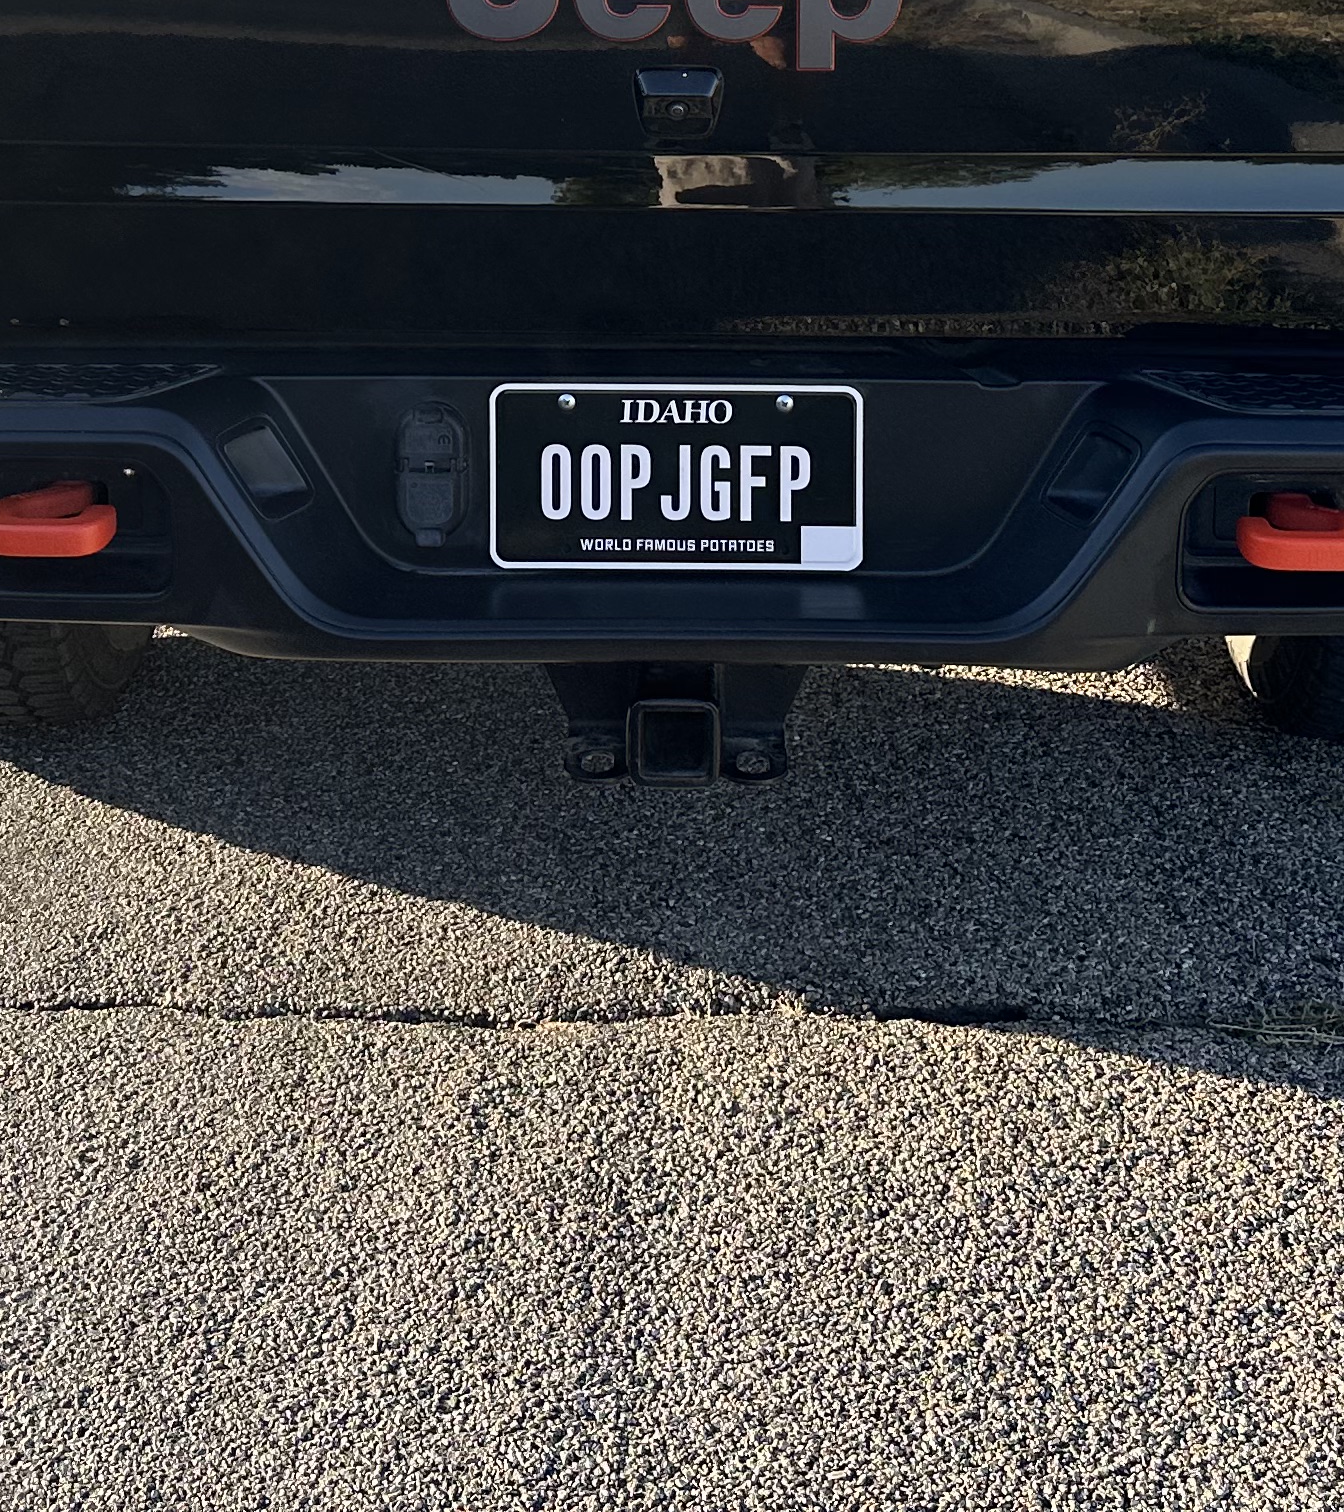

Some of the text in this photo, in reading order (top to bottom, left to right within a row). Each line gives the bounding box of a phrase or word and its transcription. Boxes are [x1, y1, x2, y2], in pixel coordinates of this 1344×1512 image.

[619, 399, 733, 424] IDAHO
[579, 538, 775, 553] WORLD FAMOUS POTATOES
